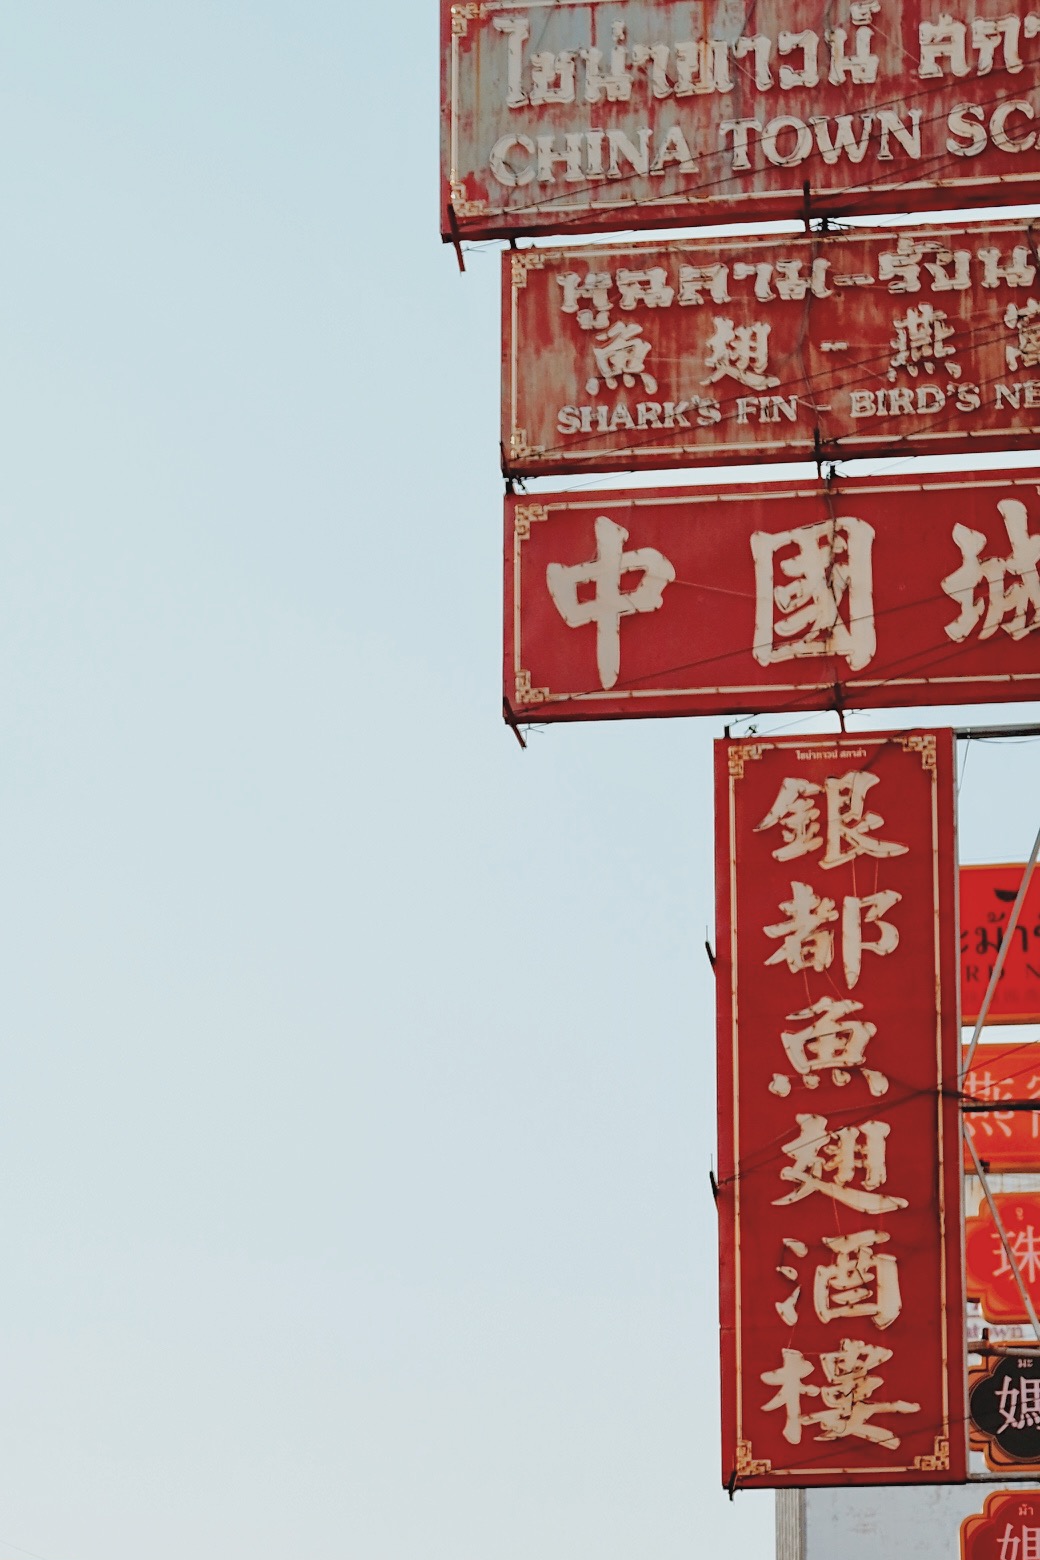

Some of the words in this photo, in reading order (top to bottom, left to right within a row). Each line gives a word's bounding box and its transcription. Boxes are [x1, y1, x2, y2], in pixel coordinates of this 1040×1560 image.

[490, 127, 699, 187] CHINA
[719, 108, 922, 171] TOWN
[946, 99, 1040, 157] SC
[557, 394, 722, 434] SHARK'S
[735, 394, 799, 425] FIN
[849, 381, 982, 419] BIRD'S
[545, 499, 1040, 691] 中國城
[752, 770, 922, 1451] 銀都魚翅酒樓
